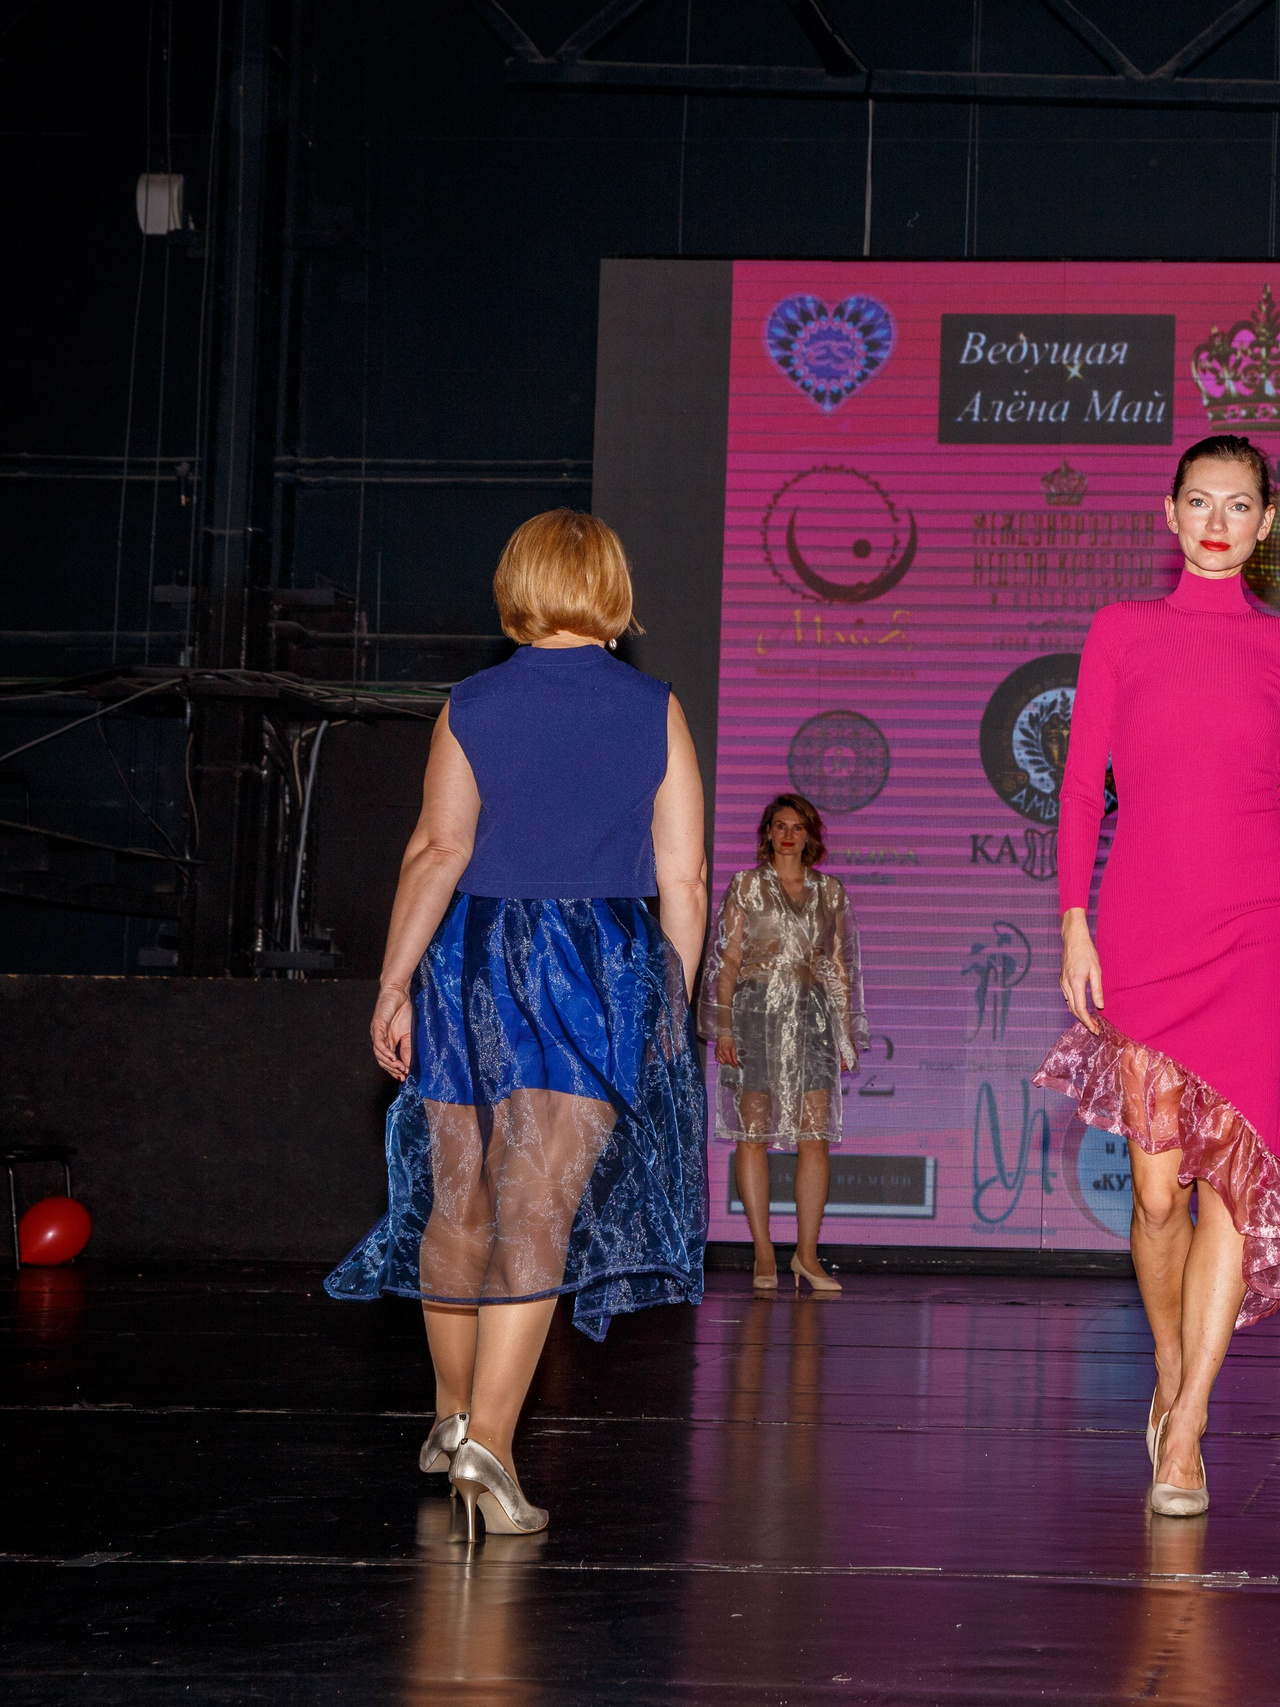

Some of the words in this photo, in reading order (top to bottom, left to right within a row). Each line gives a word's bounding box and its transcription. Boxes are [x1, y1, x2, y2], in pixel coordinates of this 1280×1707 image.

[959, 331, 1129, 374] Ведущая
[955, 390, 1070, 423] Алёна
[1083, 389, 1166, 423] Май
